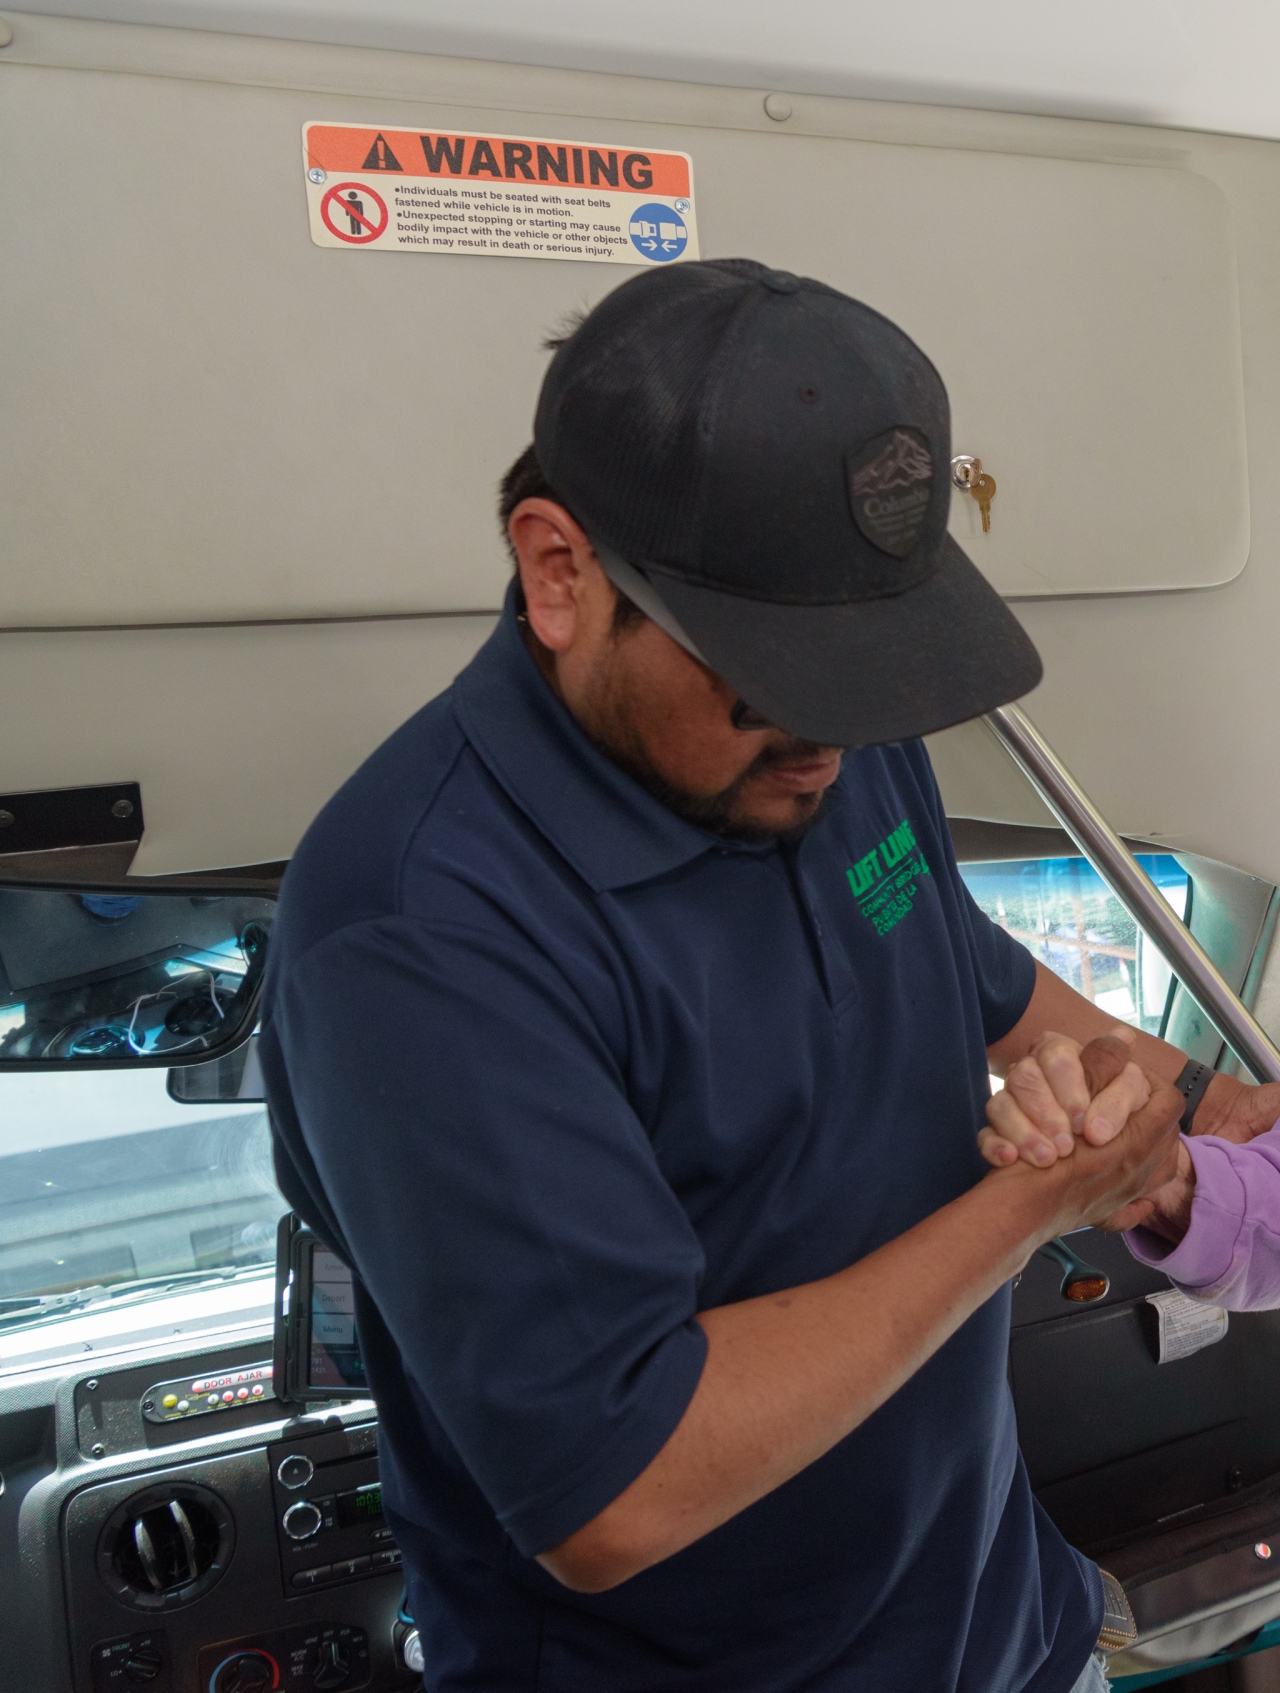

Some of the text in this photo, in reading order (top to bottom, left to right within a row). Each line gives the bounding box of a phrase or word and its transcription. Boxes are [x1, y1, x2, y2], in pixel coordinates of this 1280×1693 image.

[419, 135, 653, 190] WARNING
[395, 197, 574, 217] fastened while vehicle is in motion.
[461, 190, 487, 199] must
[490, 191, 502, 200] be
[505, 193, 538, 202] seated
[541, 195, 561, 204] with
[565, 197, 585, 206] seat
[588, 198, 611, 208] belts
[468, 214, 513, 226] stopping
[516, 217, 526, 225] or
[529, 218, 567, 230] starting
[570, 222, 590, 232] may
[593, 224, 621, 232] cause
[397, 222, 628, 245] bodily impact with the vehicle or other objects
[398, 235, 614, 257] which may result in death or serious injury.
[845, 848, 883, 897] LIFT
[324, 1263, 344, 1271] Arrive
[322, 1294, 345, 1303] Depart
[323, 1325, 343, 1333] Menu
[204, 1371, 262, 1389] DOOR AJAR
[304, 1636, 318, 1645] VENT
[323, 1630, 334, 1638] OFF
[112, 1642, 130, 1651] FRONT
